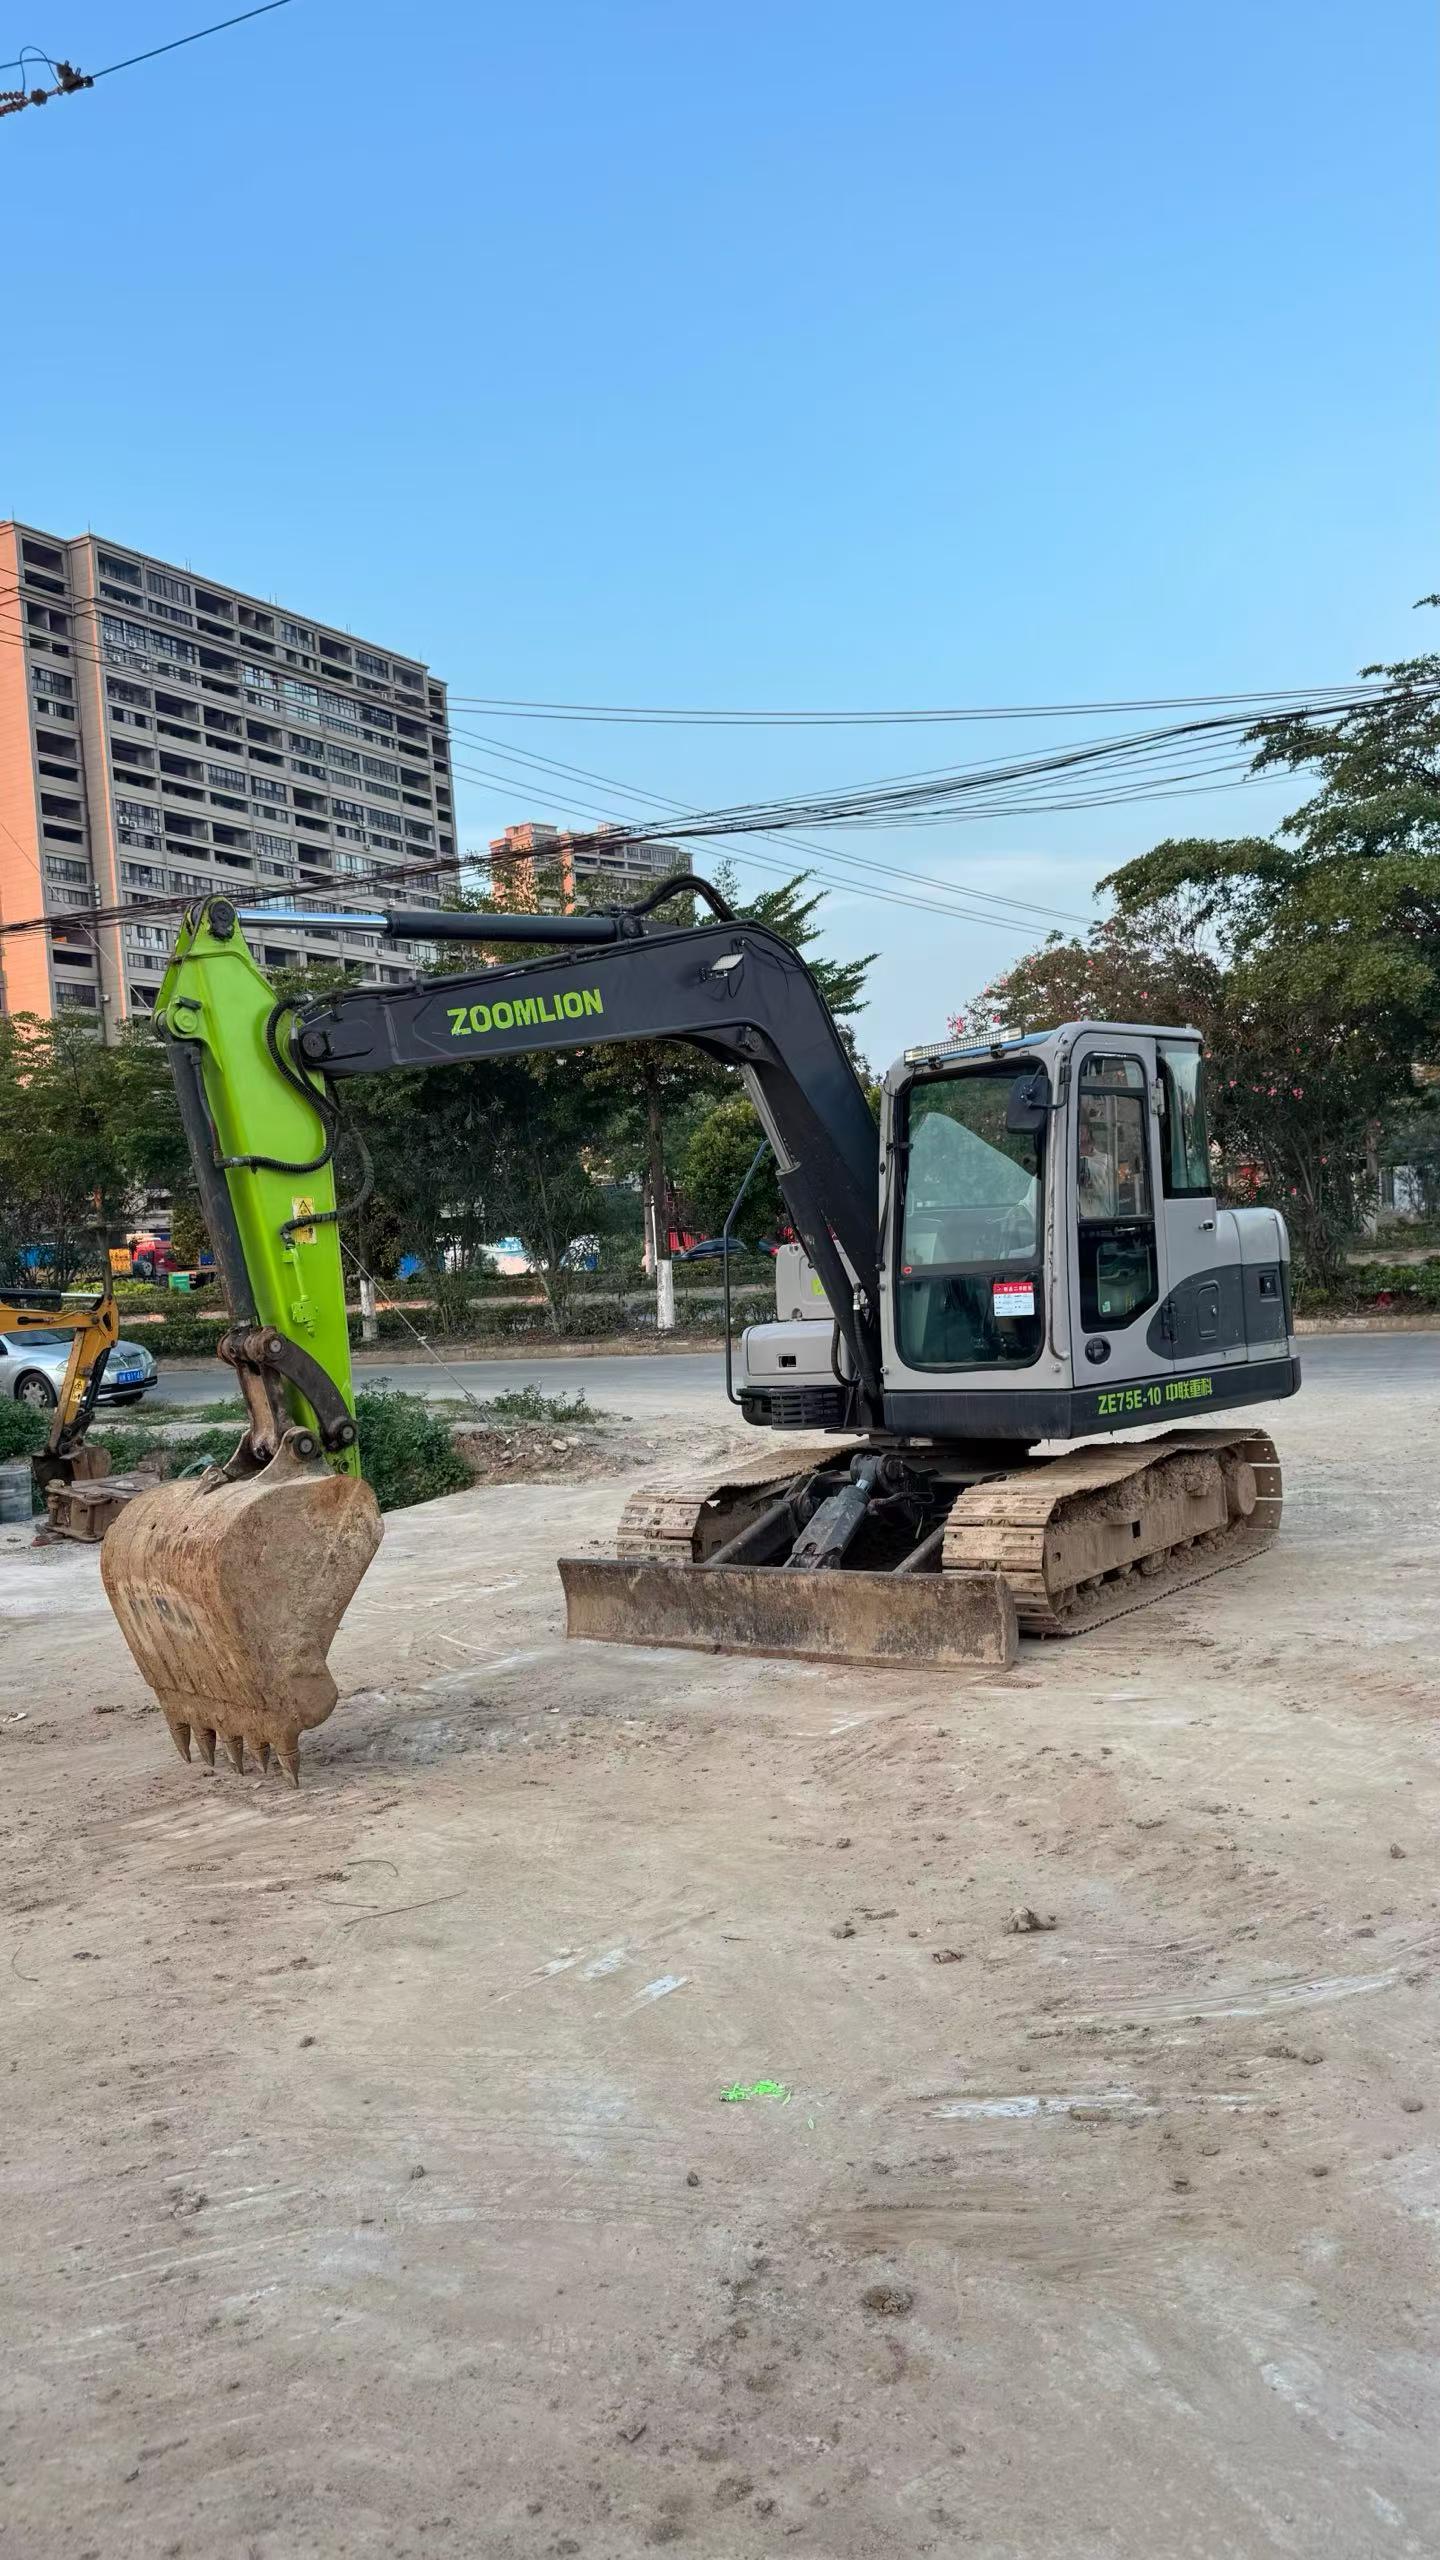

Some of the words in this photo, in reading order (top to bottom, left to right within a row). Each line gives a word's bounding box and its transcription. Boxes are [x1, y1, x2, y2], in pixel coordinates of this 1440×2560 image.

[447, 988, 604, 1036] ZOOMLION
[1098, 1387, 1162, 1415] ZE75E-10
[1165, 1377, 1213, 1402] 中联重科
